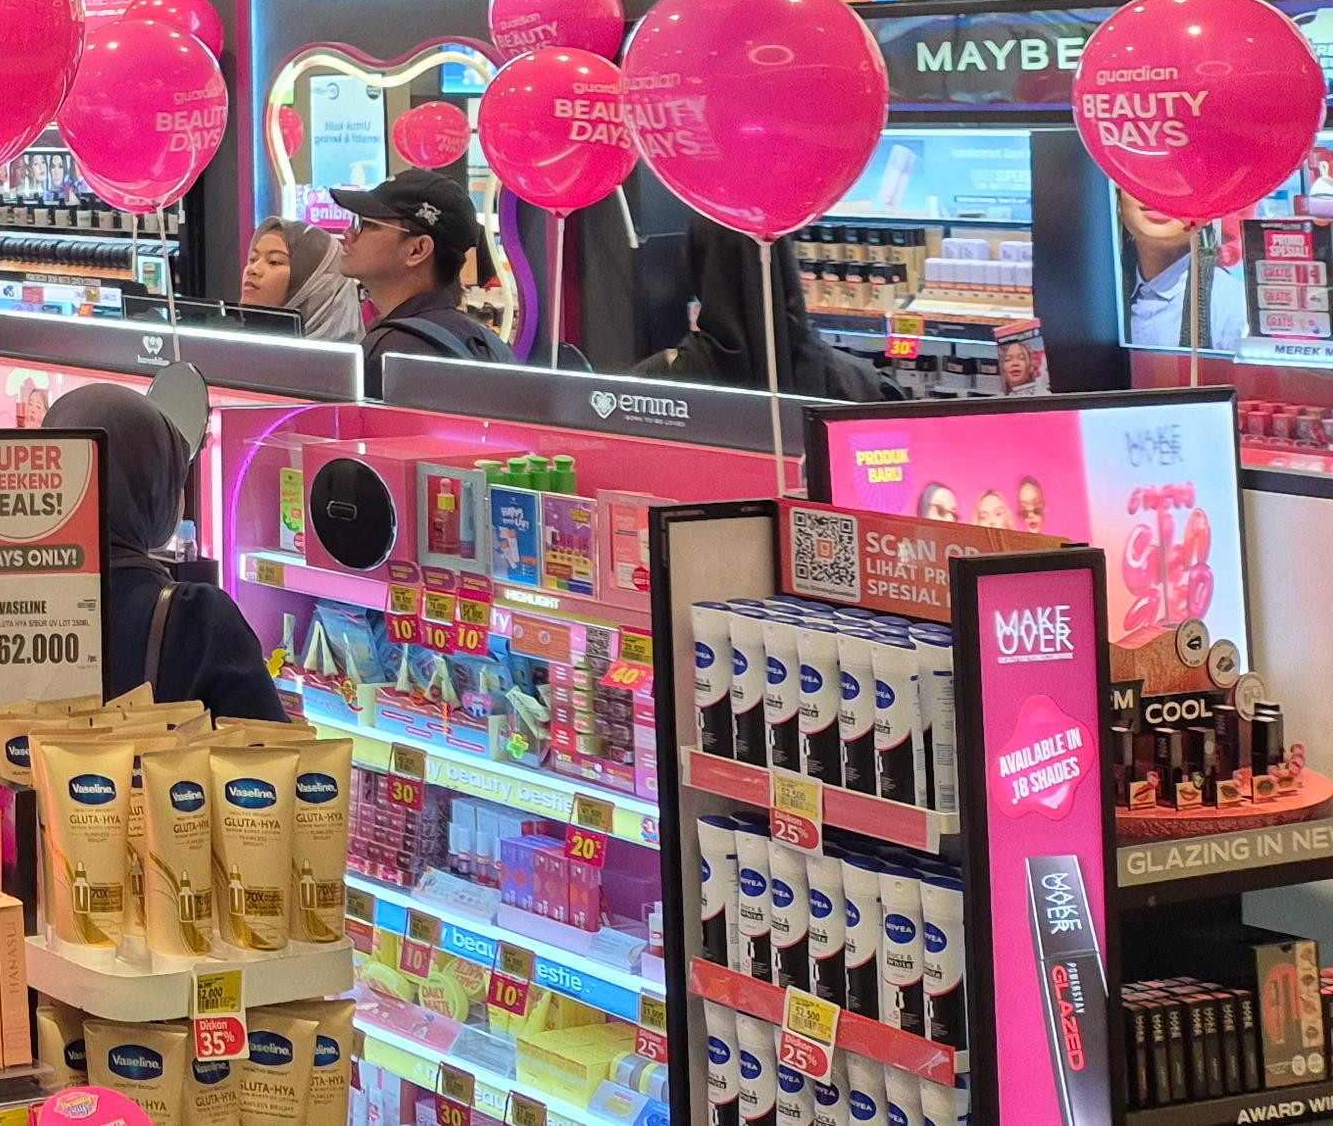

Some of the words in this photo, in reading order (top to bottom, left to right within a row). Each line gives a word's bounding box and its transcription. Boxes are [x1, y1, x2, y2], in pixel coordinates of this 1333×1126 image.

[497, 21, 559, 47] BEAUTY
[916, 38, 1084, 73] MAYBE
[1096, 65, 1178, 85] guardian
[1082, 90, 1209, 120] BEAUTY
[569, 121, 632, 150] DAYS
[1099, 120, 1190, 149] DAYS
[1275, 344, 1320, 356] MEREK
[619, 394, 689, 419] emina
[856, 448, 910, 466] PRODUK
[868, 466, 903, 482] BARU
[27, 546, 78, 568] ONLY!
[865, 531, 936, 562] SCAN
[867, 559, 918, 578] LIHAT
[504, 589, 561, 611] HIGHLIGHT
[867, 578, 941, 606] SPESIAL
[0, 600, 47, 615] VASELINE
[994, 605, 1071, 638] MAKE
[997, 622, 1075, 655] OVER
[1145, 697, 1212, 726] COOL
[999, 734, 1062, 779] AVAILABLE
[1065, 727, 1083, 753] IN
[447, 762, 513, 799] beauty
[517, 779, 573, 813] bestie
[1013, 780, 1025, 802] 18
[1027, 754, 1081, 799] SHADES
[70, 814, 121, 825] GLUTA-HYA
[224, 818, 281, 830] GLUTA-HYA
[296, 812, 343, 824] GLUTA-HYA
[773, 821, 810, 845] 25%
[1126, 842, 1250, 875] GLAZING
[1257, 832, 1284, 857] IN
[885, 922, 913, 934] NIVEA
[9, 921, 18, 994] HANASUI
[420, 987, 445, 1002] DAILY
[1066, 962, 1086, 1014] POWERSTAY
[199, 1020, 228, 1031] Diskon
[1051, 964, 1086, 1072] GLAZED
[200, 1031, 235, 1056] 35%
[113, 1056, 161, 1070] Vaseline
[782, 1044, 818, 1070] 25%
[1237, 1101, 1305, 1125] AWARD
